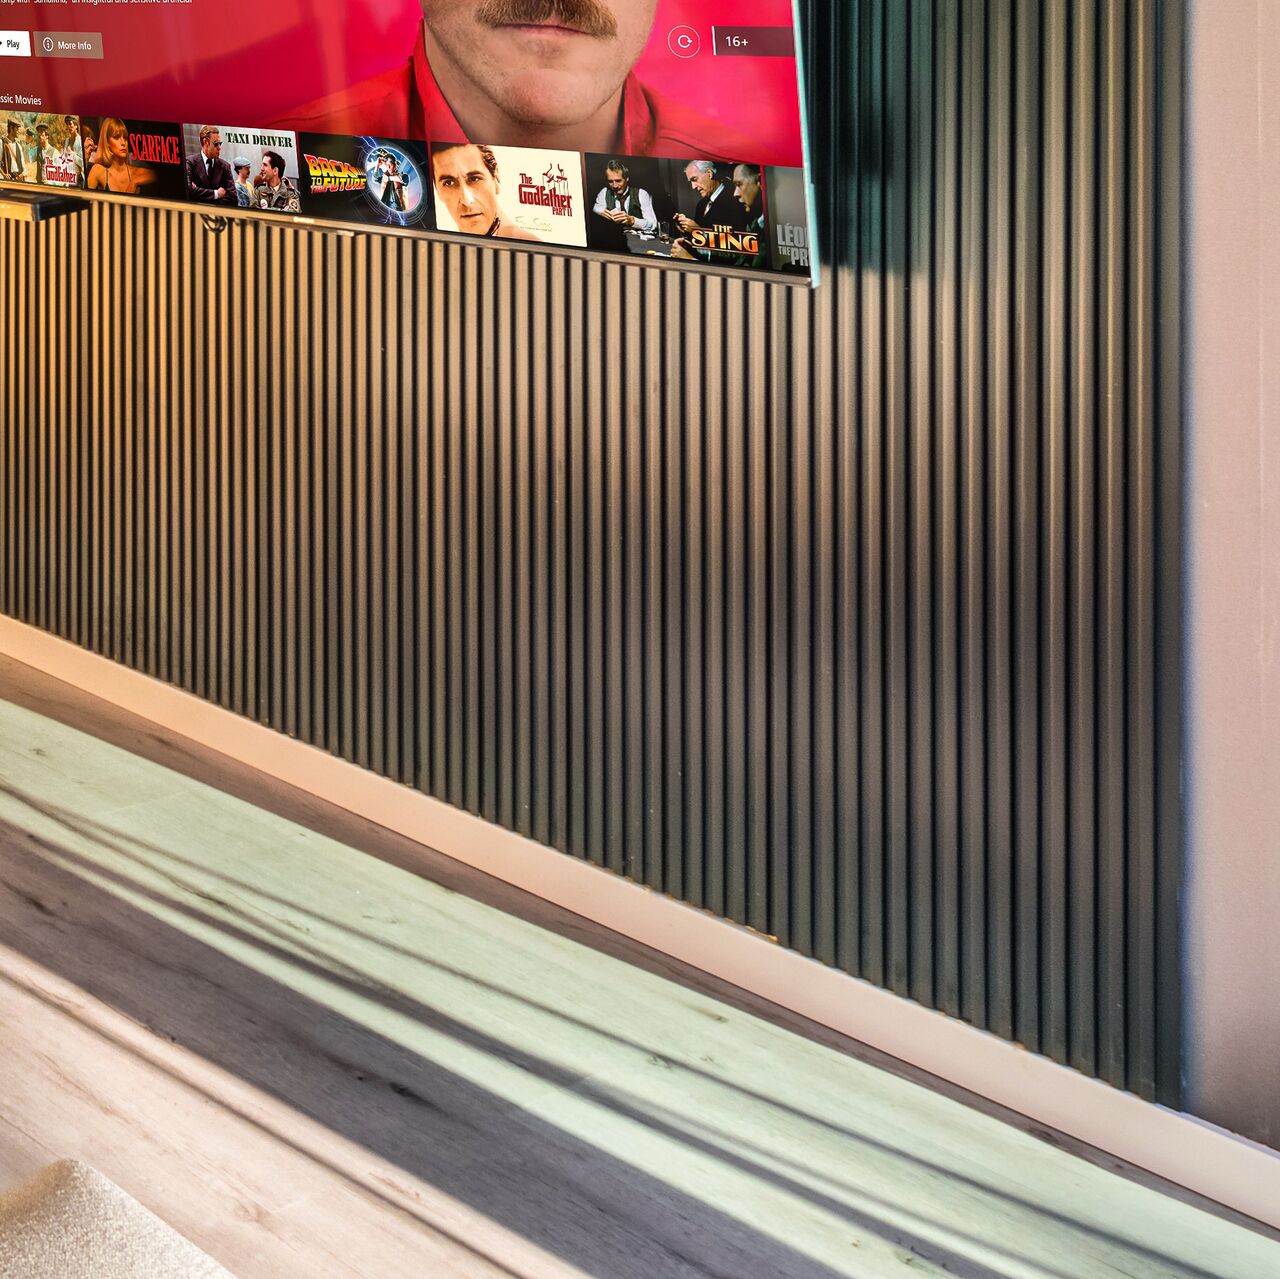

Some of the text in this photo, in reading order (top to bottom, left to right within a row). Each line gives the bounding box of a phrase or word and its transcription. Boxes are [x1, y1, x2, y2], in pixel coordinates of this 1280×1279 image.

[7, 40, 20, 50] Play
[58, 41, 92, 50] More Info
[725, 35, 749, 47] 16+
[15, 94, 42, 106] Movies
[225, 132, 293, 148] TAXI DRIVER
[129, 133, 181, 164] SCARFACE
[45, 156, 53, 165] The
[304, 153, 366, 178] BACK
[45, 164, 77, 183] Godfather
[519, 173, 533, 184] The
[311, 177, 322, 186] TO
[323, 177, 367, 192] FUTURE
[518, 184, 572, 208] Godfather
[552, 206, 573, 217] PART II
[712, 219, 733, 229] THE
[692, 229, 759, 253] STING
[778, 245, 791, 256] THE
